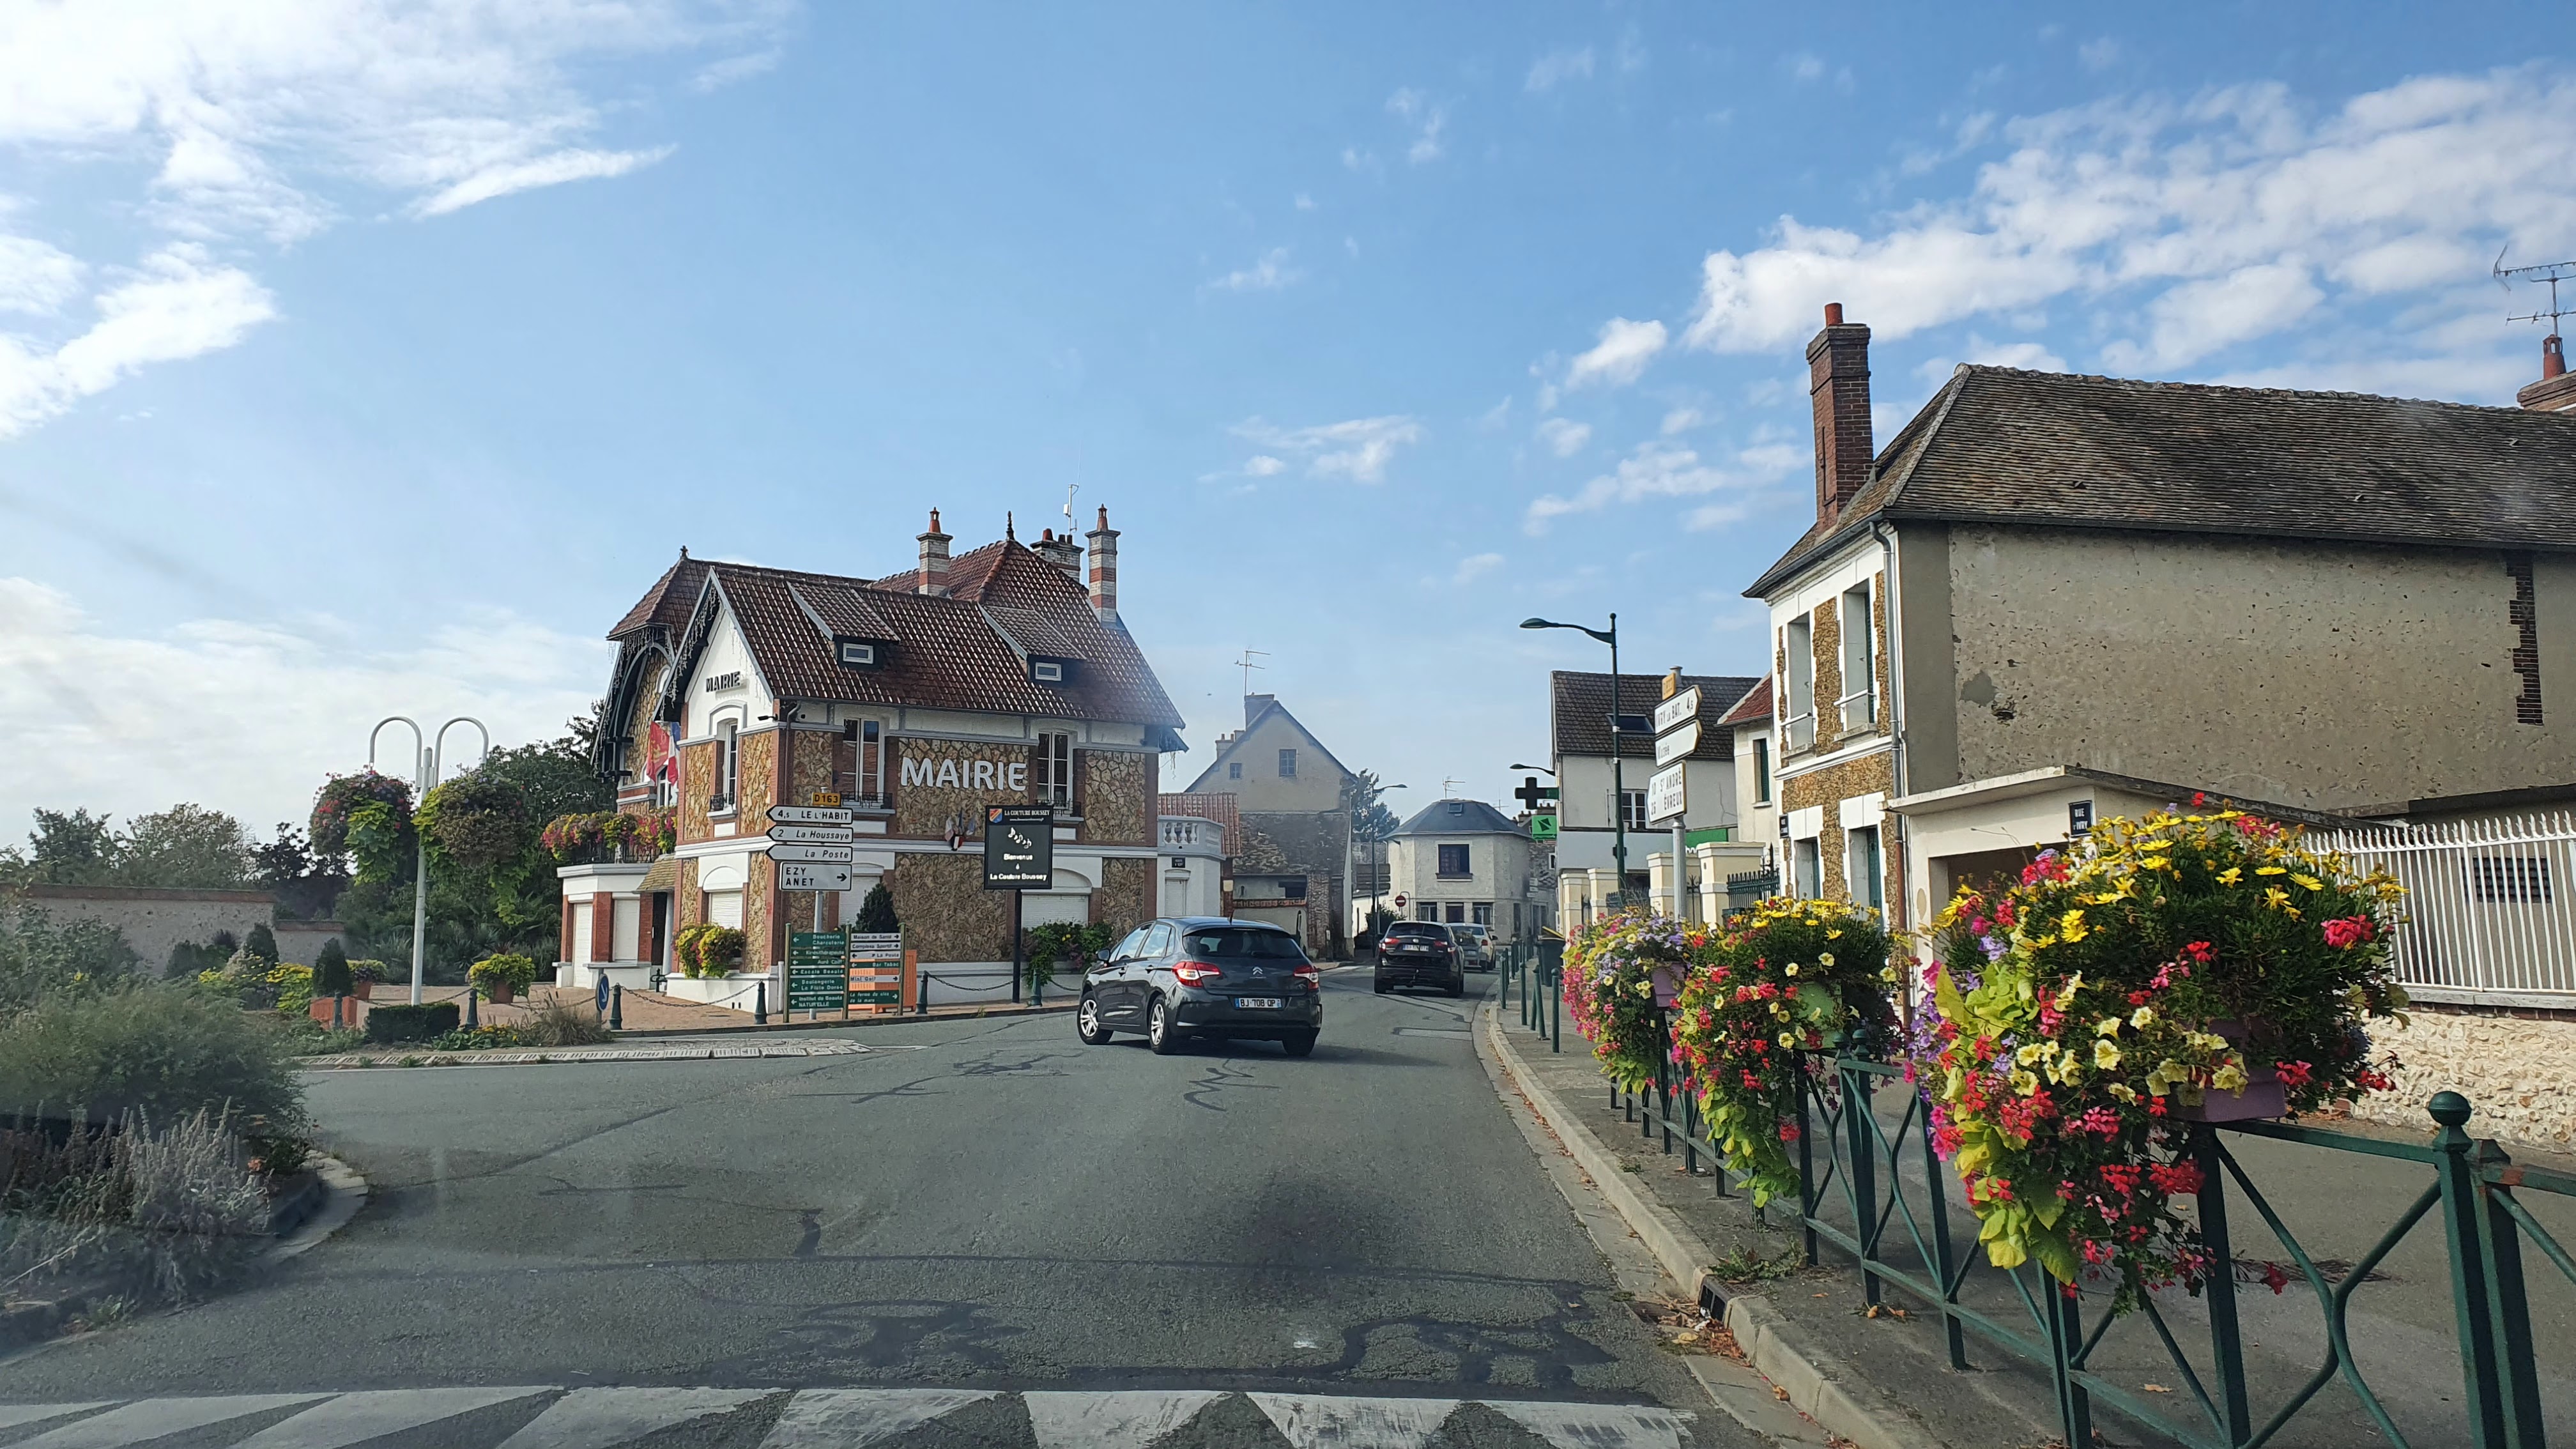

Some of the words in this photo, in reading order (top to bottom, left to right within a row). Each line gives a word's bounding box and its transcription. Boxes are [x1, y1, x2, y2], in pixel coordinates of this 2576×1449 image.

[706, 671, 740, 693] MAIRIE
[901, 756, 1027, 791] MAIRIE
[1664, 790, 1682, 811] ÉVREUX
[778, 809, 790, 819] 4,5
[2074, 808, 2085, 817] RUE
[809, 831, 850, 840] Houssaye
[786, 878, 814, 886] ANET
